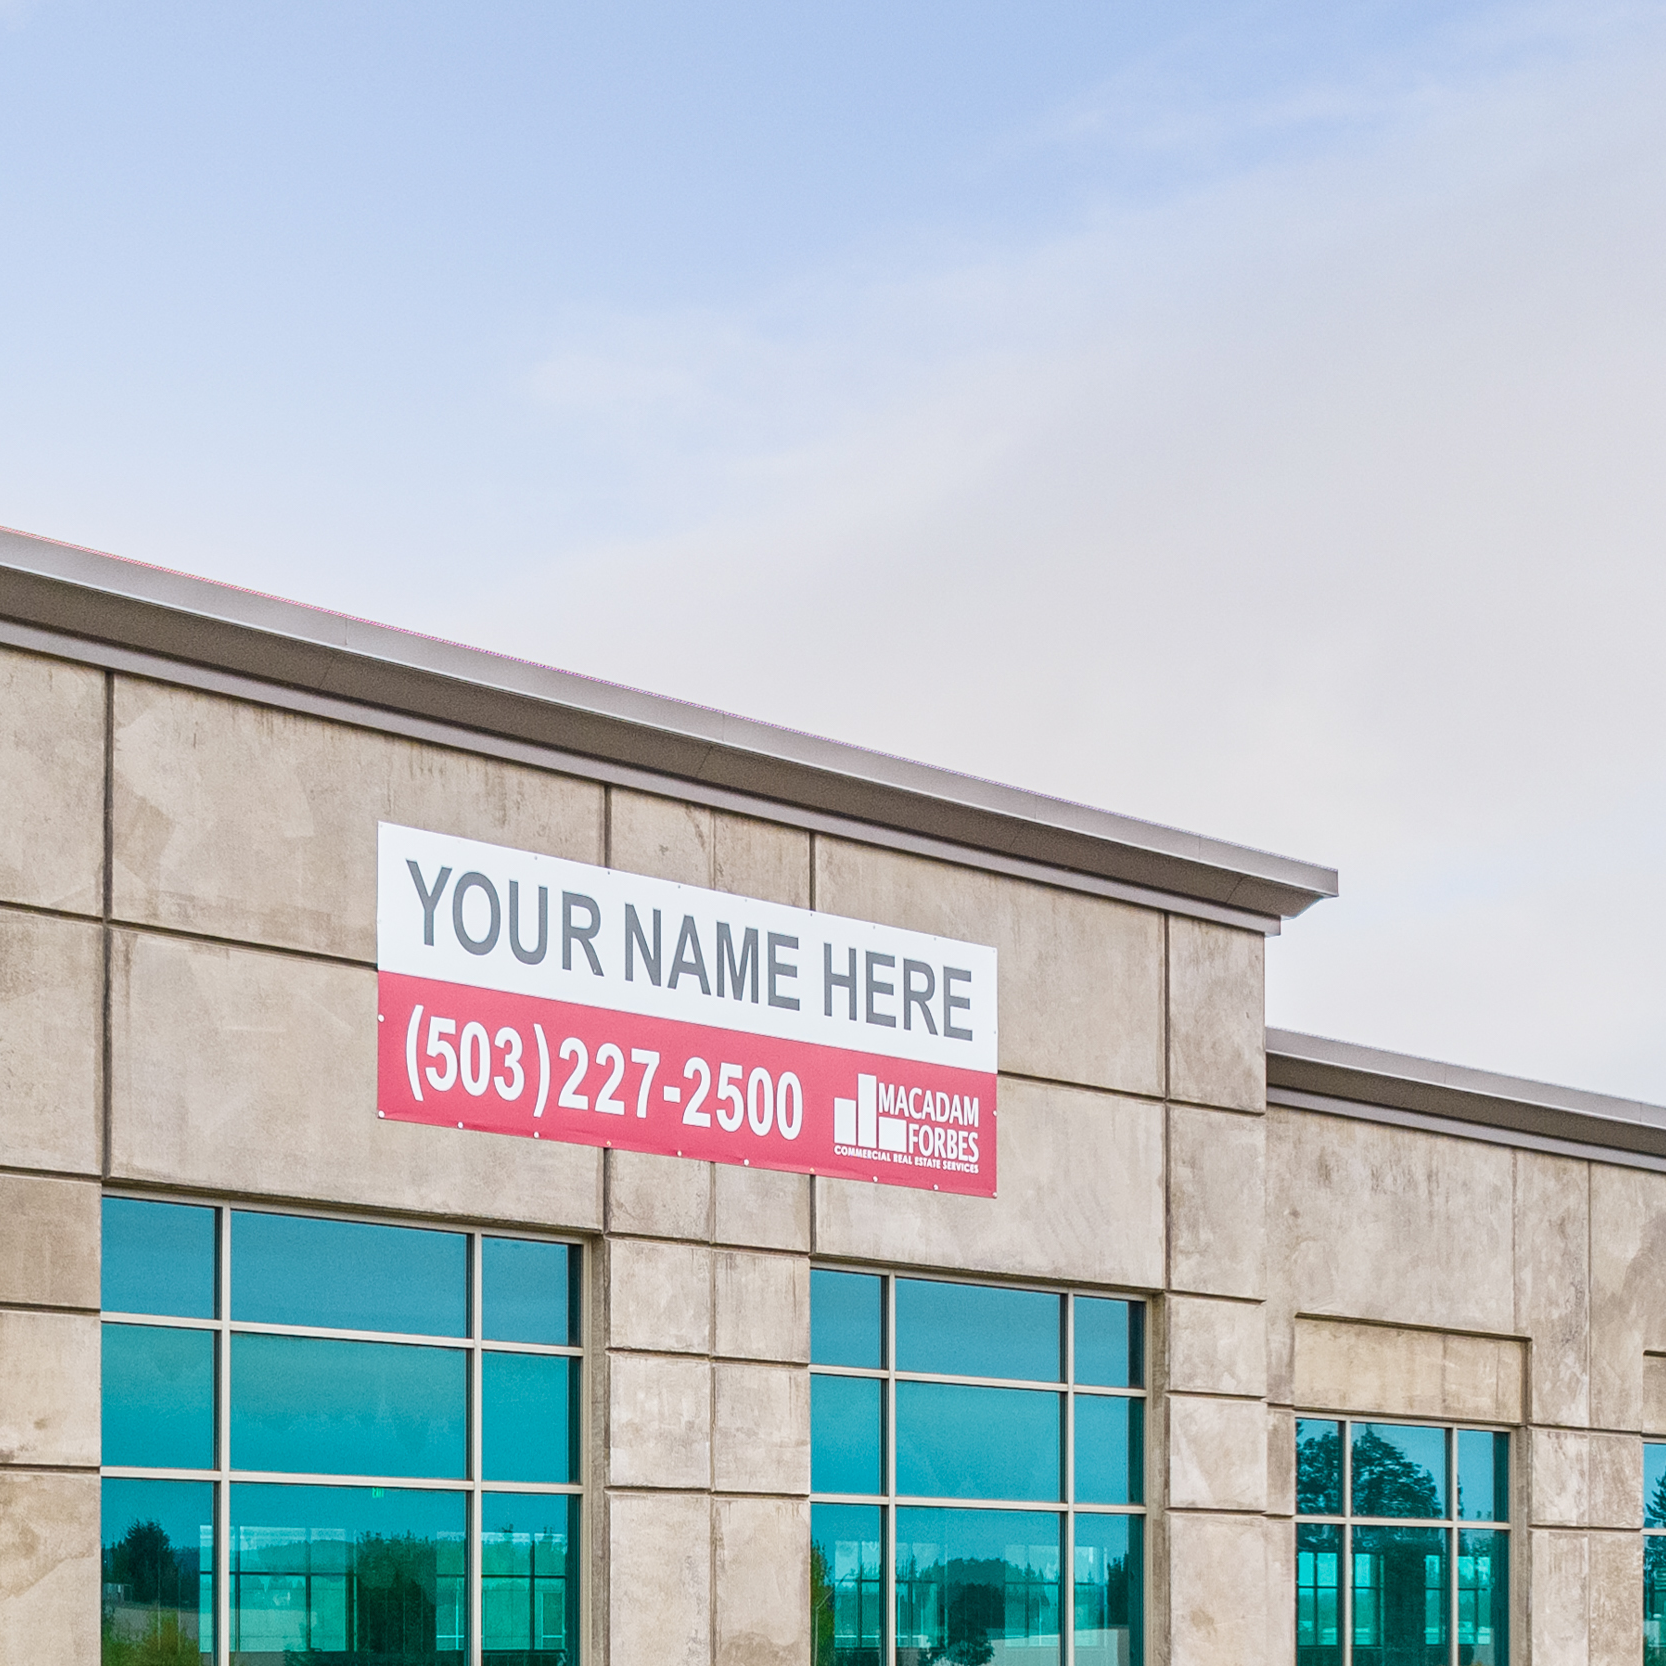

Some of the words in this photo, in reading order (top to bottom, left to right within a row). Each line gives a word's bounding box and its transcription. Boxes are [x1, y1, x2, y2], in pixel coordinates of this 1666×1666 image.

[406, 859, 604, 977] YOUR
[624, 903, 801, 1012] NAME
[823, 942, 974, 1042] HERE
[405, 1004, 803, 1141] (503)227-2500
[878, 1082, 979, 1128] MACADAM
[834, 1145, 891, 1162] COMMERCIAL
[893, 1154, 913, 1165] REAL
[914, 1157, 941, 1169] ESTATE
[942, 1160, 979, 1174] SERVICES
[908, 1123, 979, 1163] FORBES
